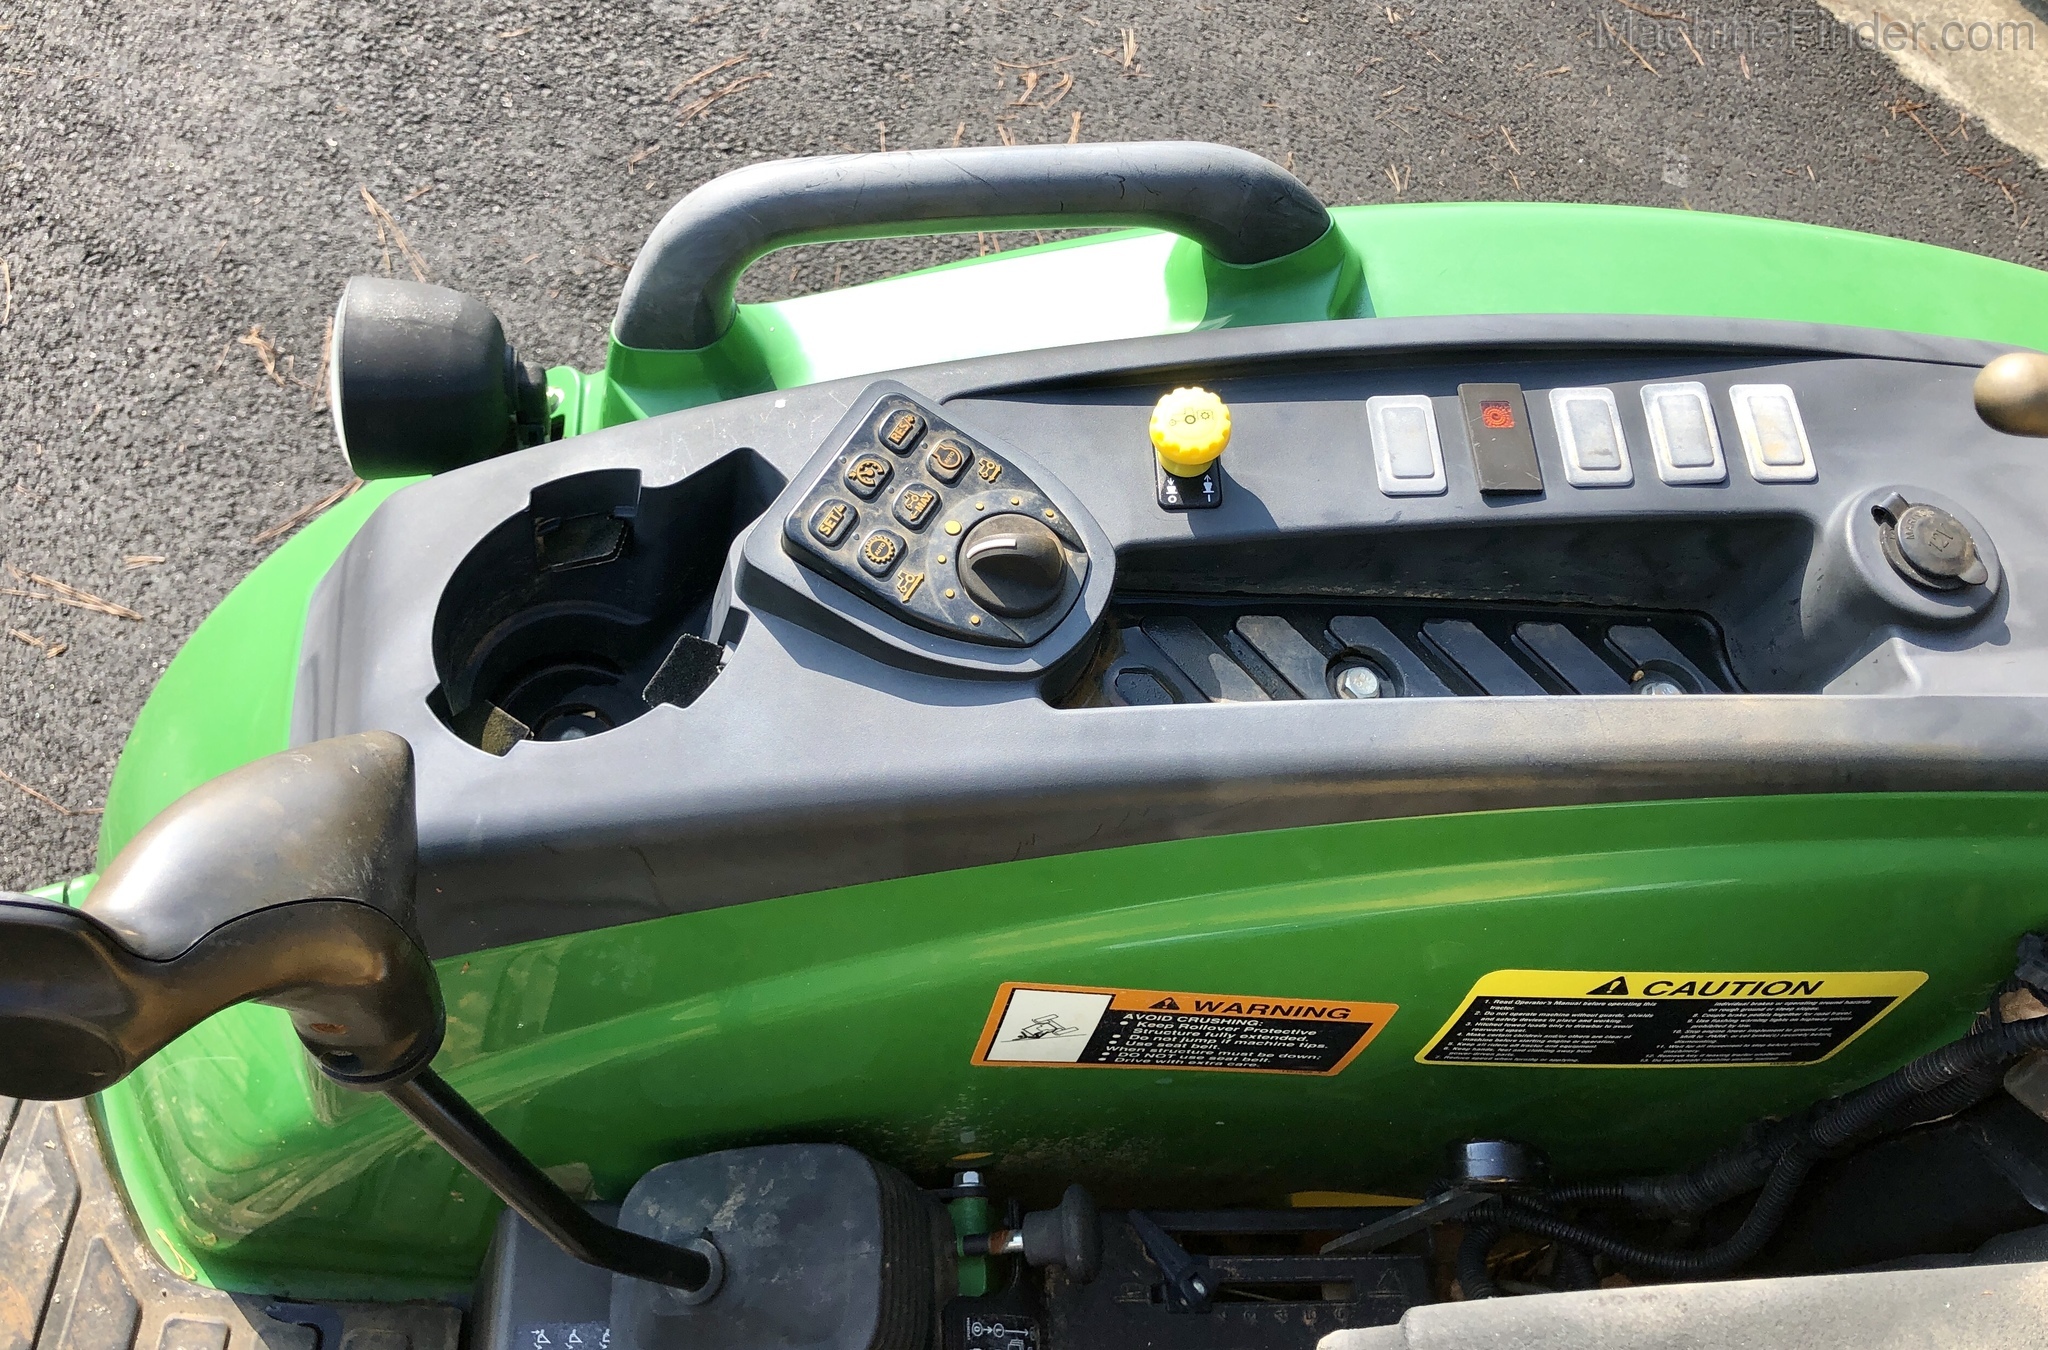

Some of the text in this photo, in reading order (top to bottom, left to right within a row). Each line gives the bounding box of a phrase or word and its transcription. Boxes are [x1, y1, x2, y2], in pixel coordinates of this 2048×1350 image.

[915, 492, 934, 513] MAX
[875, 543, 885, 556] AUTO
[1642, 980, 1824, 996] CAUTION
[1195, 1000, 1351, 1019] WARNING
[1136, 1021, 1317, 1036] Keep Rollover Protective
[1177, 1016, 1264, 1027] CRUSHING:
[1133, 1028, 1309, 1042] Structure fully extended.
